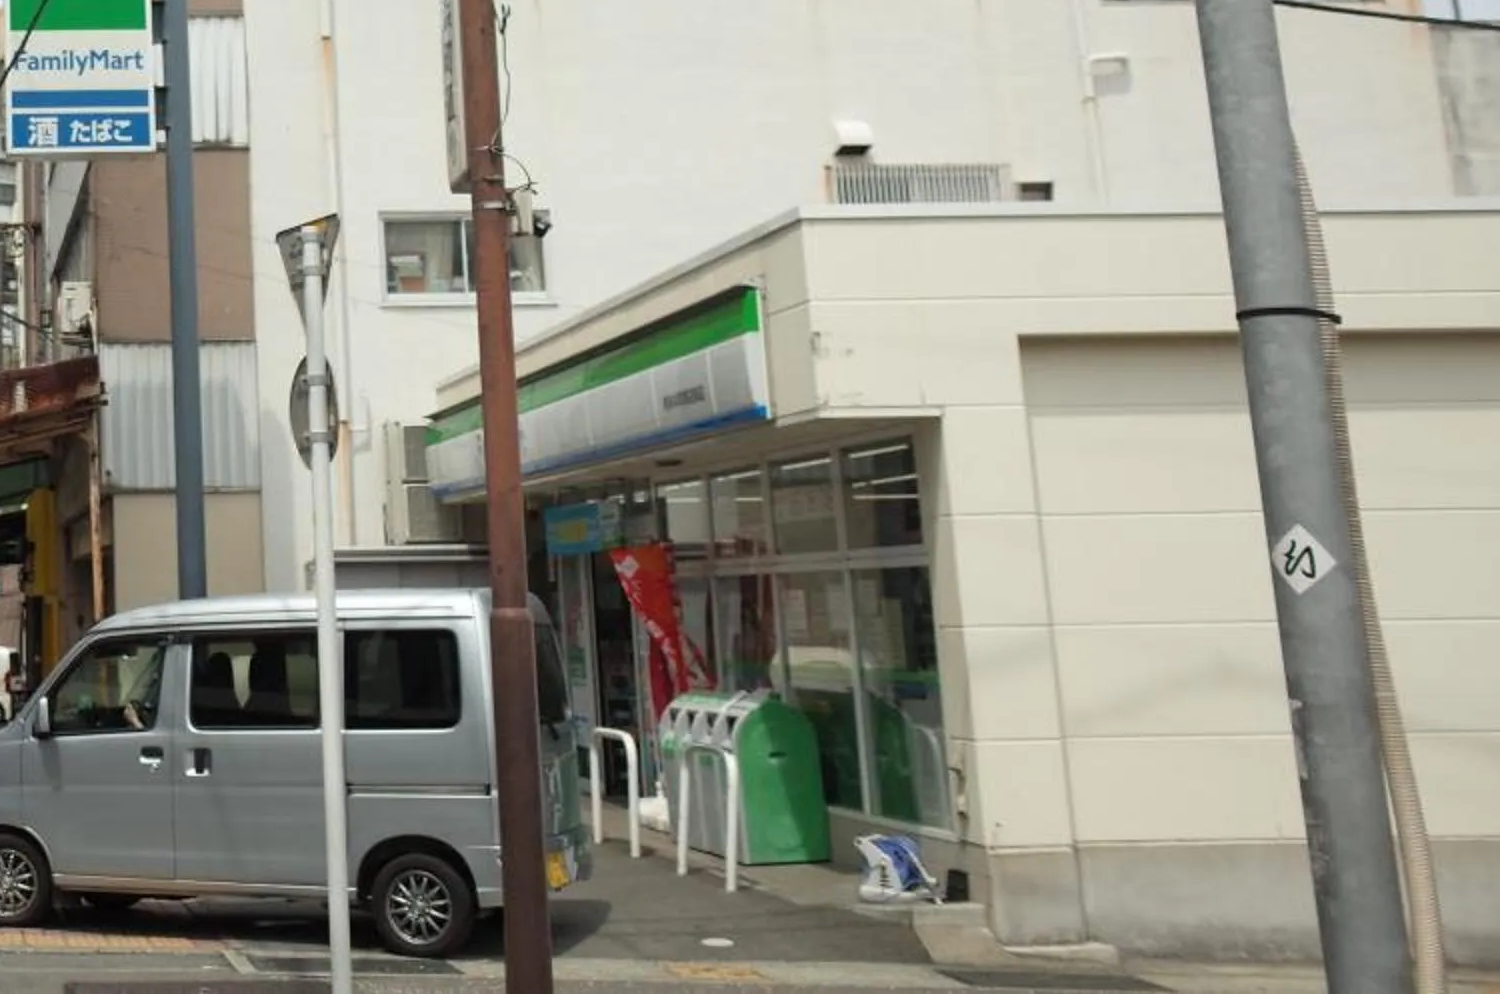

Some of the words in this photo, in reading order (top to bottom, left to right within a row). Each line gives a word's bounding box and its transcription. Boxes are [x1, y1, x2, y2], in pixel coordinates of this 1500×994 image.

[12, 49, 145, 77] FamilyMart
[27, 116, 60, 147] 酒
[68, 117, 133, 143] たばこ
